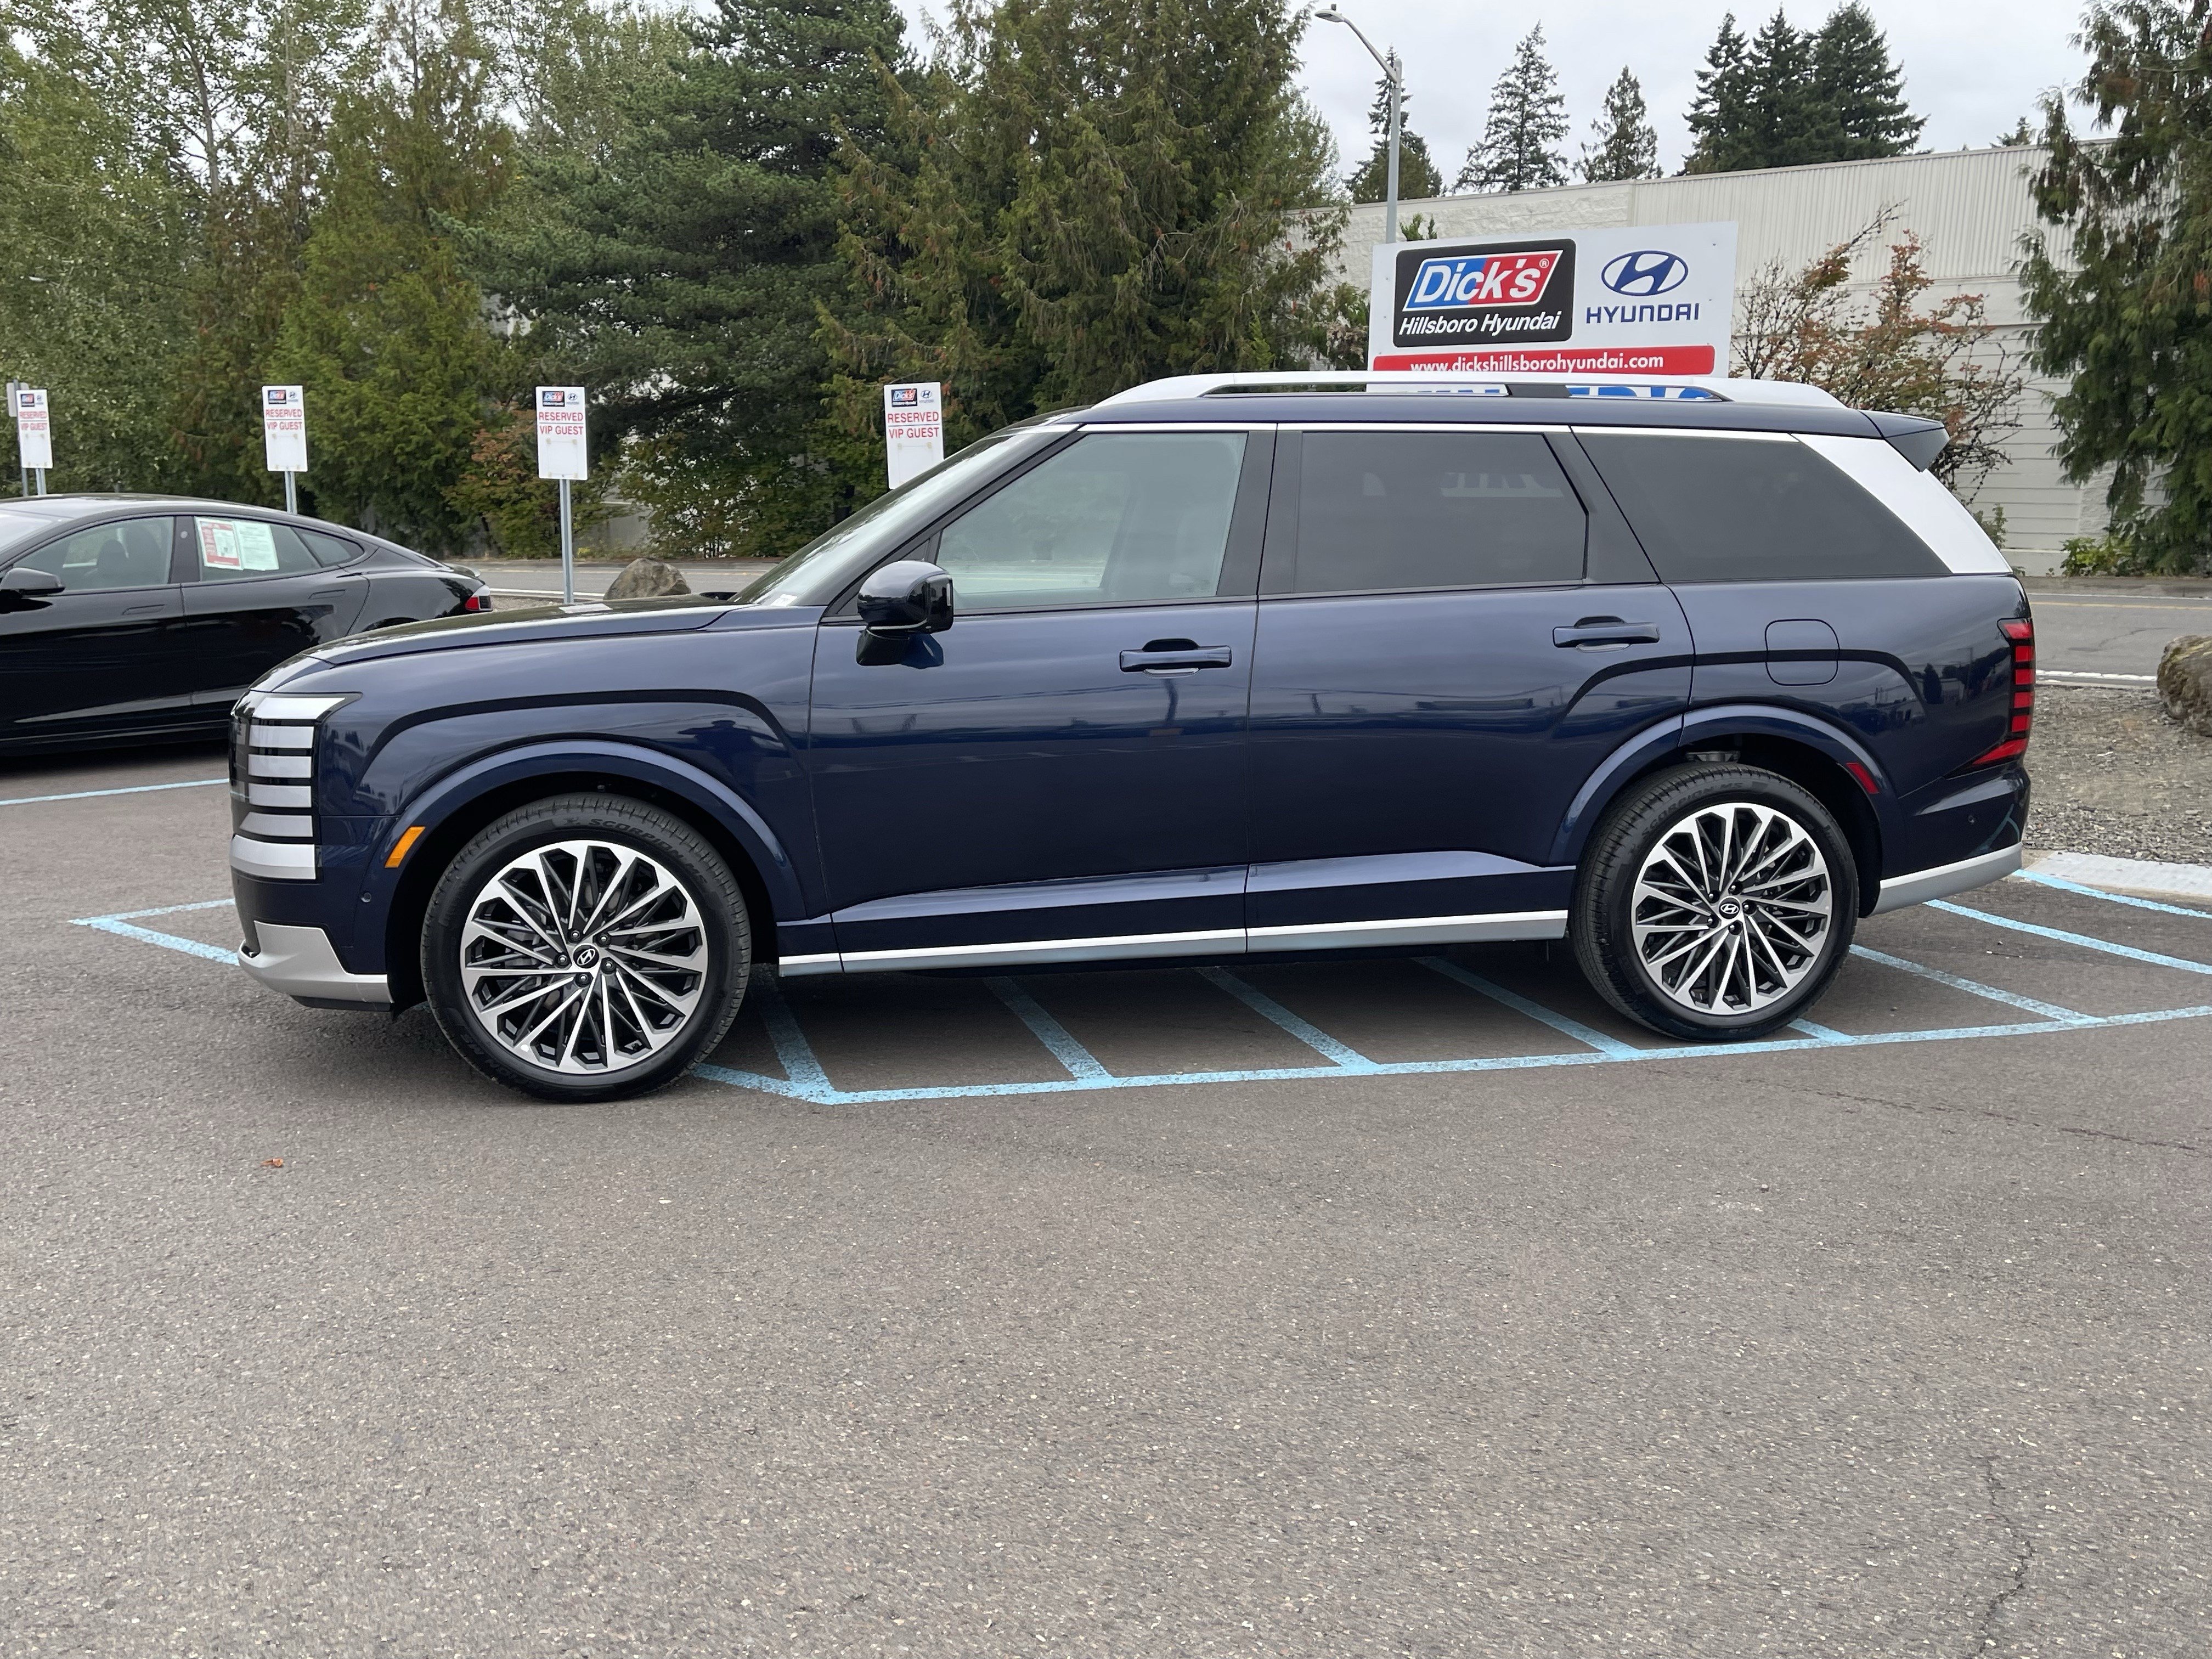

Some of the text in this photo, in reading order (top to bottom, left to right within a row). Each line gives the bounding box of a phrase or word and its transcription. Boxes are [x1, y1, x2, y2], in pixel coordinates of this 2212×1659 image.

[1585, 302, 1700, 324] HYUNDAI
[1398, 311, 1562, 336] Hillsboro Hyundai
[1410, 351, 1664, 373] www.dickshillsborohyundai.com
[266, 409, 302, 417] RESERVED
[539, 412, 584, 421] RESERVED
[888, 411, 939, 423] RESERVED
[267, 422, 303, 430] VIP GUEST
[540, 426, 584, 435] VIP GUEST
[889, 427, 940, 438] VIP GUEST
[589, 818, 685, 861] SCORPION
